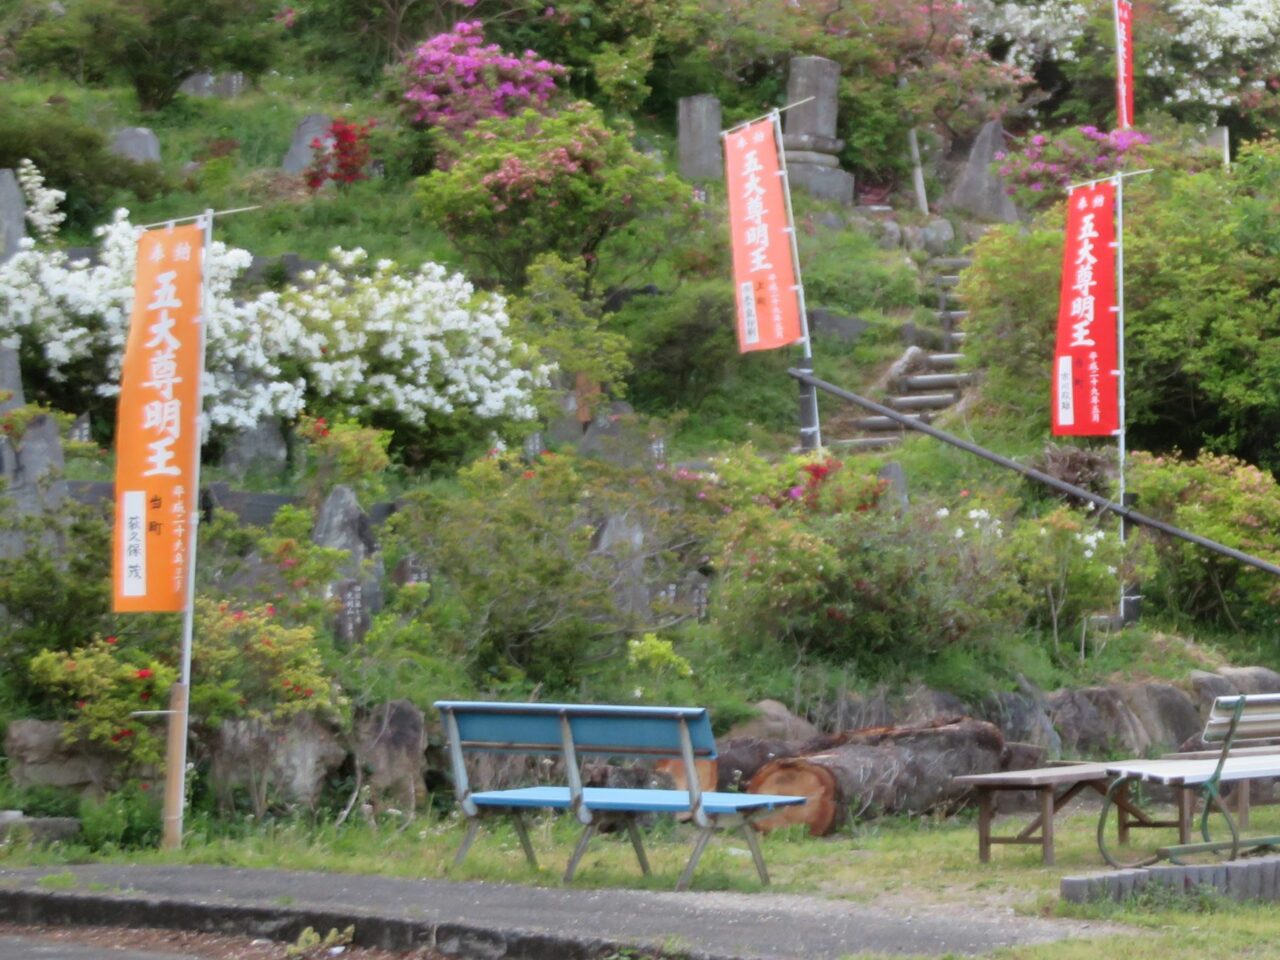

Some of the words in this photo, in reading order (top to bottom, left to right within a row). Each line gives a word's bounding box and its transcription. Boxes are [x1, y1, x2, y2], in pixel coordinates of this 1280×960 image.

[149, 240, 191, 262] 奉納
[741, 150, 773, 273] 五大尊明王
[1069, 213, 1099, 347] 五大尊明王
[141, 270, 183, 477] 五大尊明王
